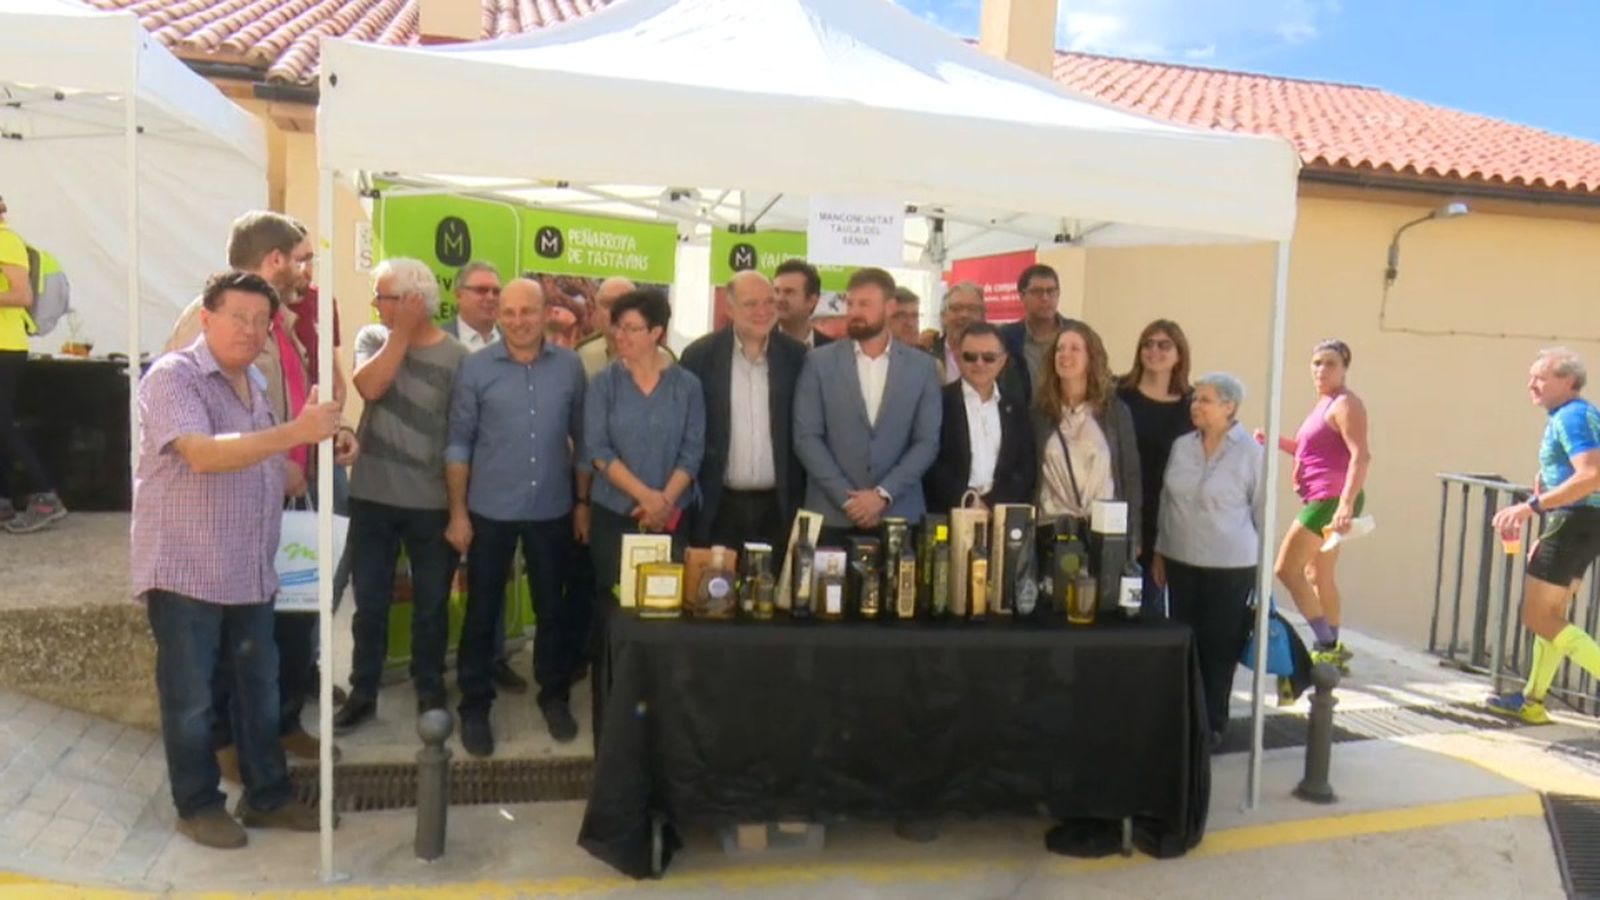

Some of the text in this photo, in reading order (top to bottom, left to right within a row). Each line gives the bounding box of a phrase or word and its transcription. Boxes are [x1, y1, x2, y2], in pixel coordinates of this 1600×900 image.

[819, 211, 894, 224] MANCOMUNITAT
[831, 223, 880, 235] TAULA DEL
[568, 228, 637, 251] PEÑARROYA
[568, 247, 649, 271] DE TASTAVINS
